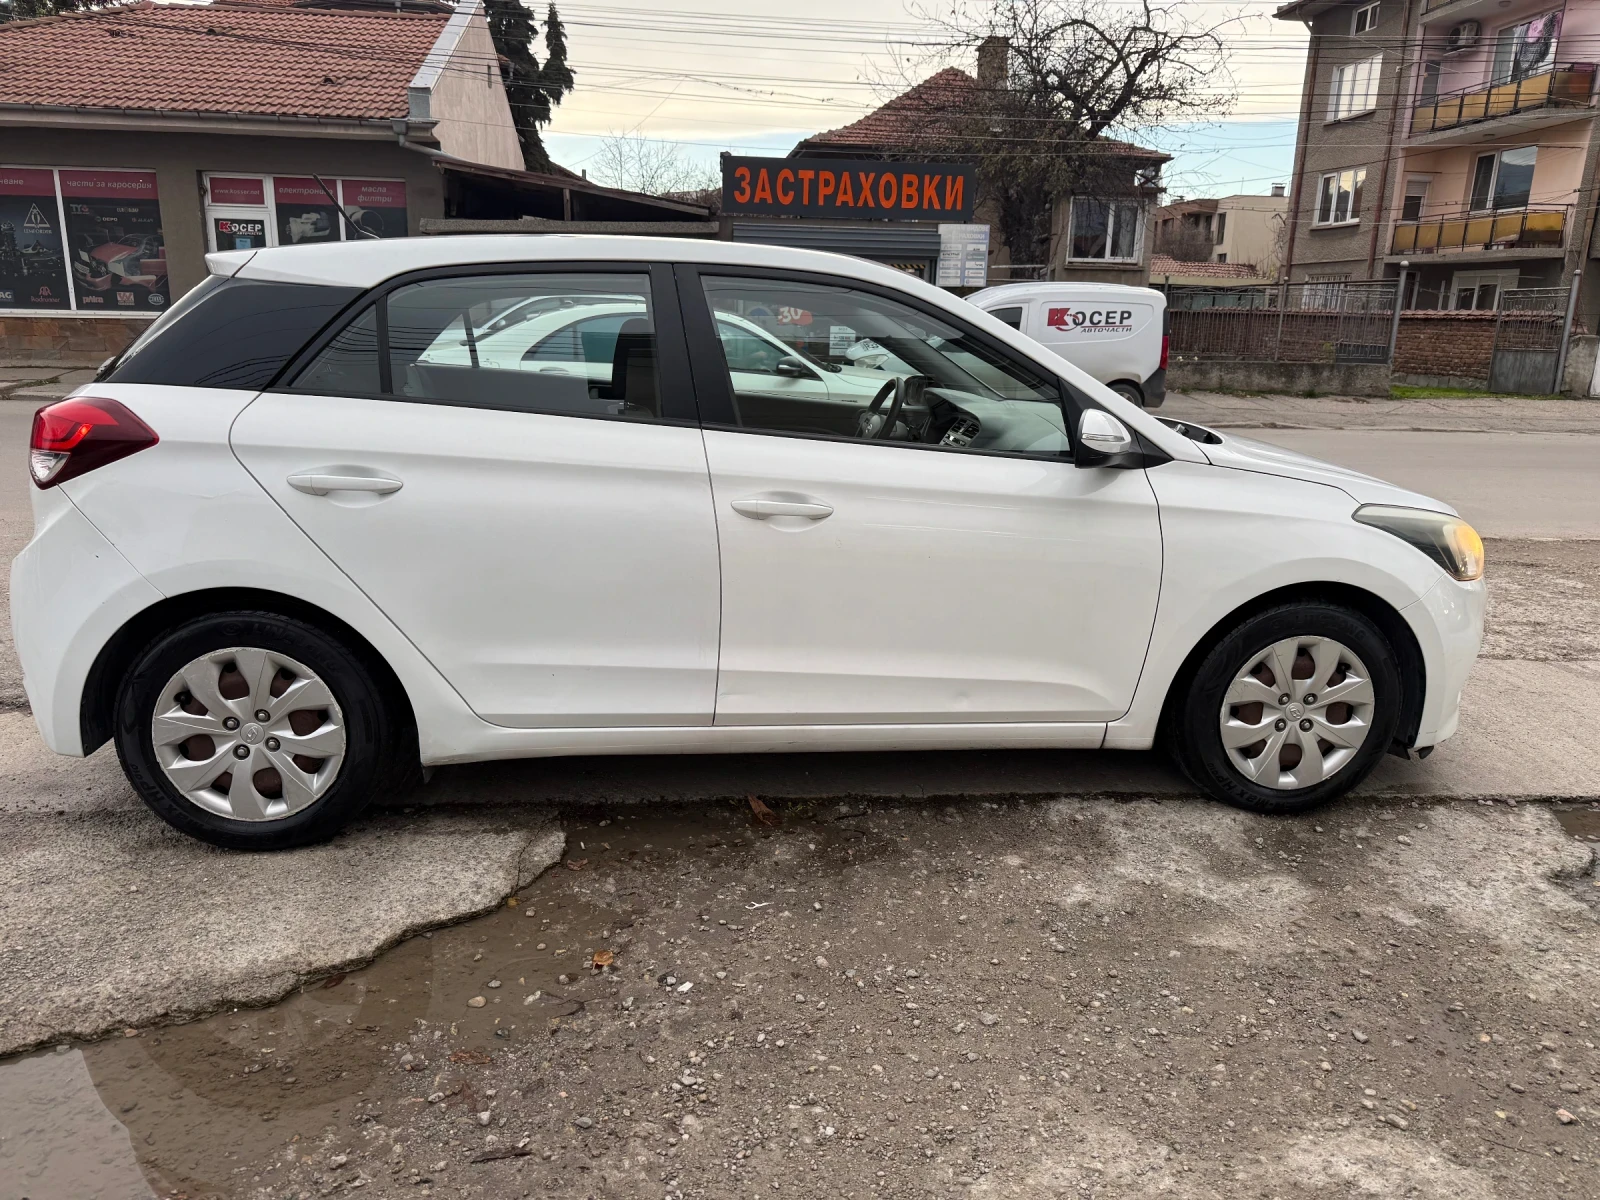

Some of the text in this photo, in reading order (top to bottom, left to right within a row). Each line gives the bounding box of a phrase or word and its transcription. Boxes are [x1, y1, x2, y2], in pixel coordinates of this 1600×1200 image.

[107, 182, 152, 190] каросерия
[733, 166, 964, 211] ЗАСТРАХОВКИ
[357, 194, 392, 203] филтри
[219, 221, 262, 233] КОСЕР
[1047, 308, 1132, 328] КОСЕР
